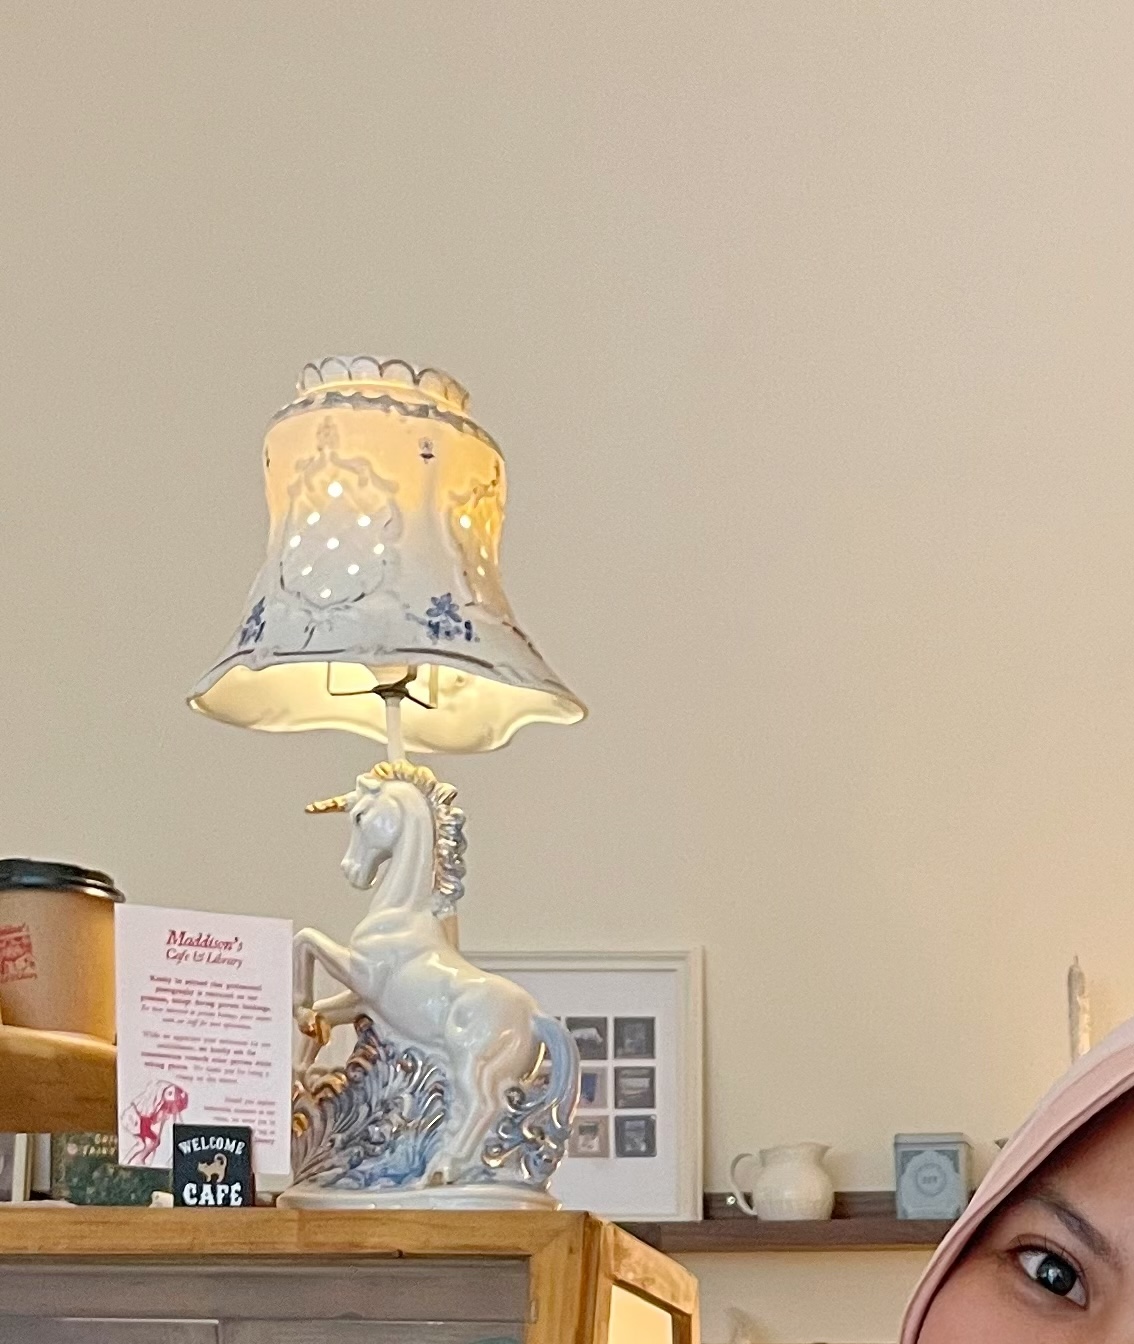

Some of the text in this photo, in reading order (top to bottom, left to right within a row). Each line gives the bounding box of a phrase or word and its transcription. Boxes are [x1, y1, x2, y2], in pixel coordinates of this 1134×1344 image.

[166, 929, 243, 952] Maddison's
[206, 952, 243, 970] Library
[178, 1136, 246, 1155] WELCOME
